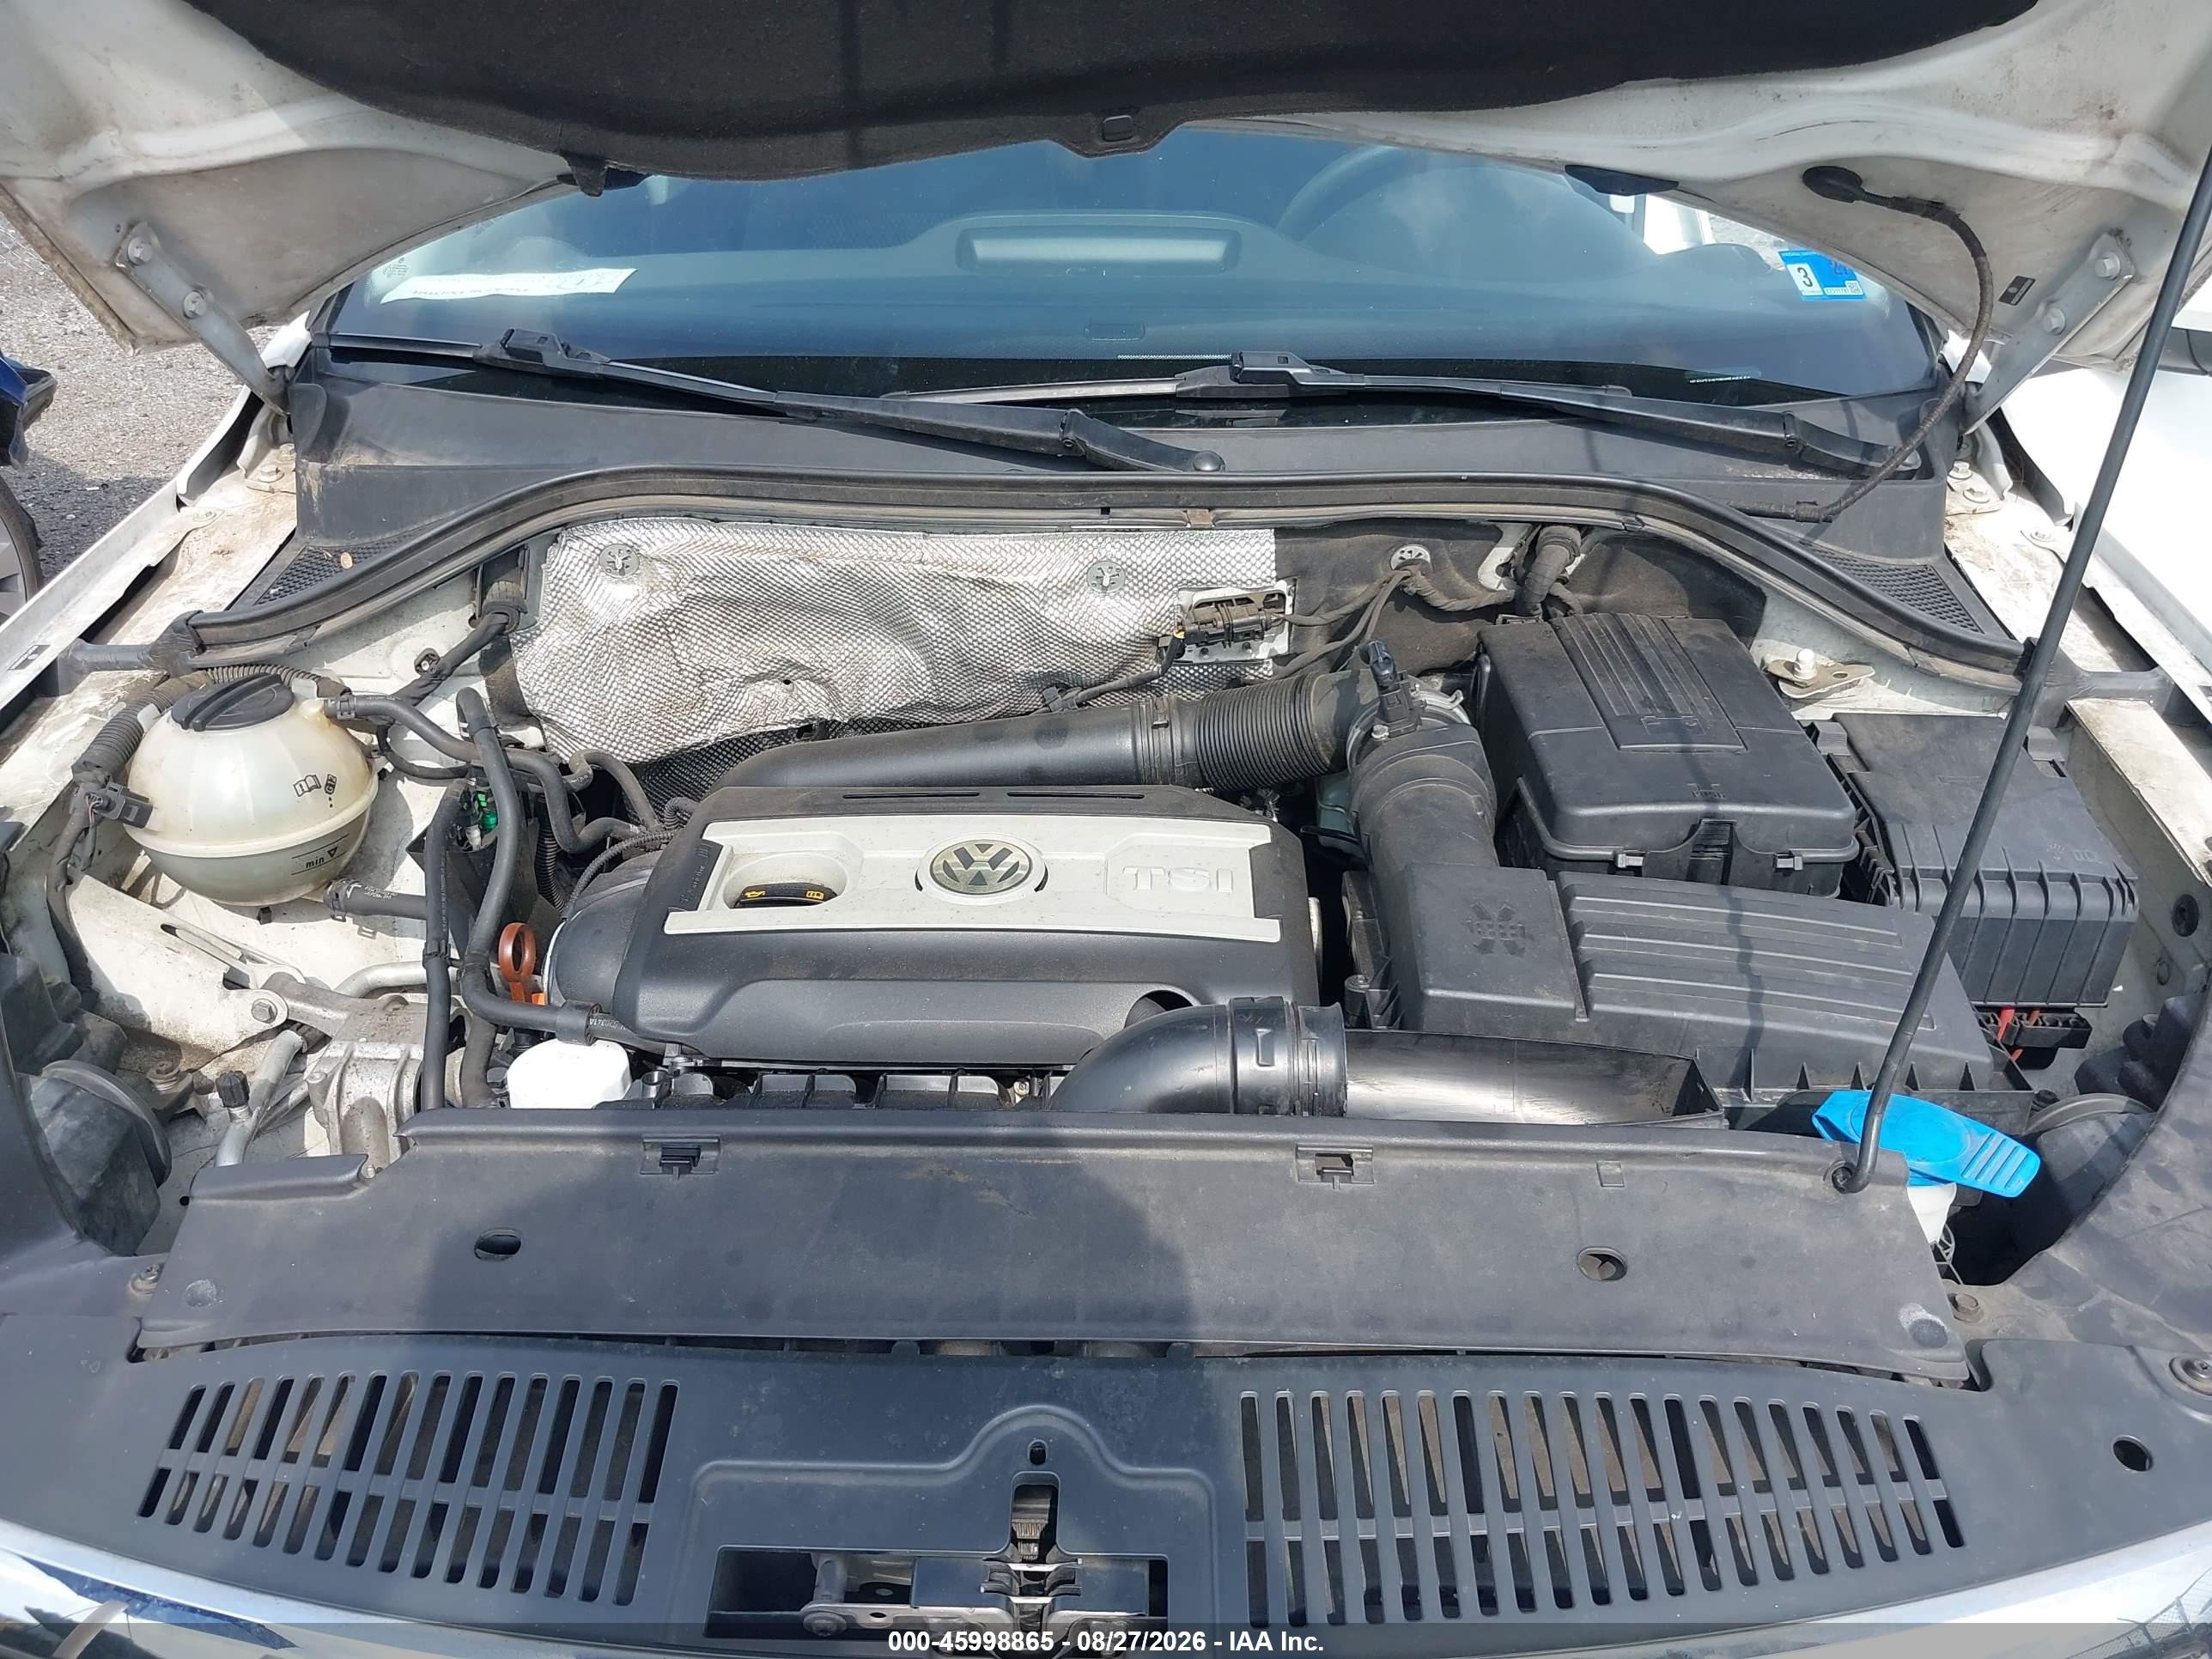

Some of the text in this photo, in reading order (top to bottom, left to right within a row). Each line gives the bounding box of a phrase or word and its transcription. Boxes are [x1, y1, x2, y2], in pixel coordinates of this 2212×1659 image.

[1796, 266, 1814, 288] 3
[305, 855, 325, 869] min
[1122, 865, 1234, 894] TSI
